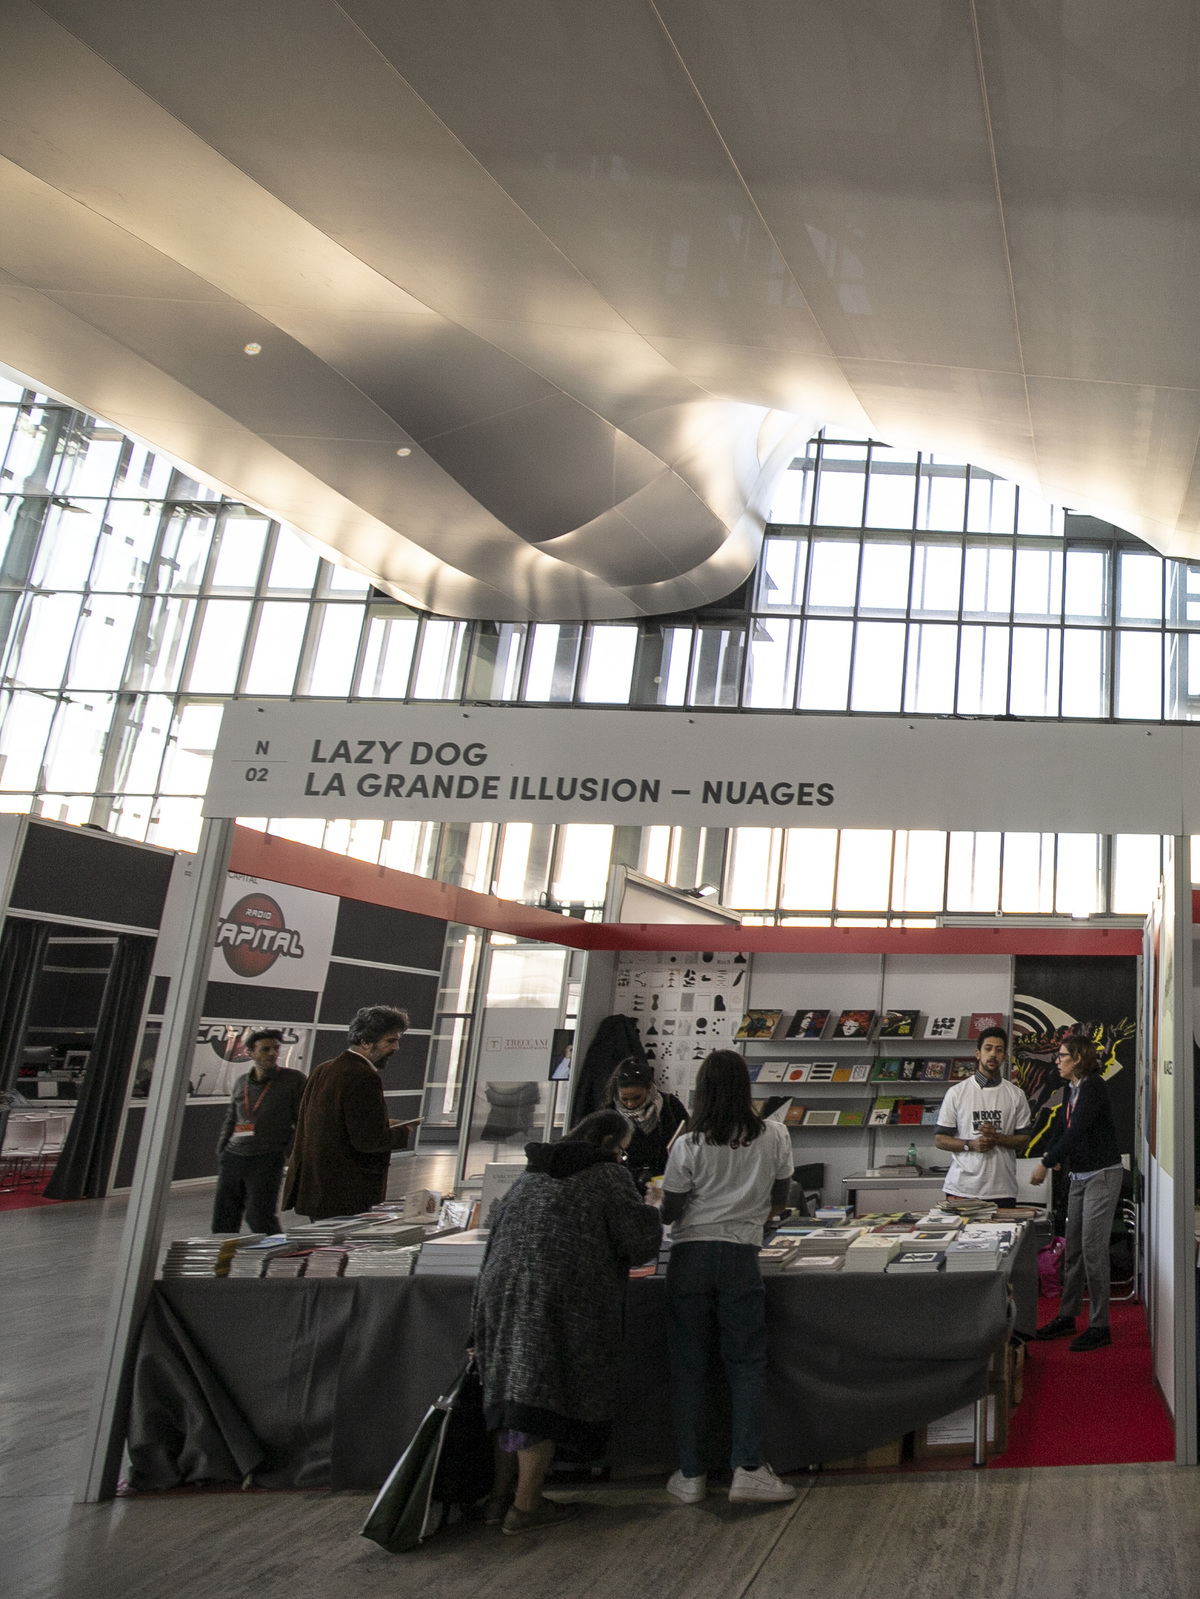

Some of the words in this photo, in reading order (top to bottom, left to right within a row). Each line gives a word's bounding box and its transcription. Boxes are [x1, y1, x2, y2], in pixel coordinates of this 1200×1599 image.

[254, 740, 270, 756] N
[310, 739, 403, 765] LAZY
[409, 741, 488, 767] DOG
[244, 767, 269, 783] 02
[303, 772, 347, 797] LA
[356, 773, 501, 800] GRANDE
[509, 776, 661, 803] ILLUSION
[701, 780, 835, 807] NUAGES
[244, 908, 273, 920] RADIO
[215, 920, 304, 956] APITAL
[972, 1110, 980, 1121] IN
